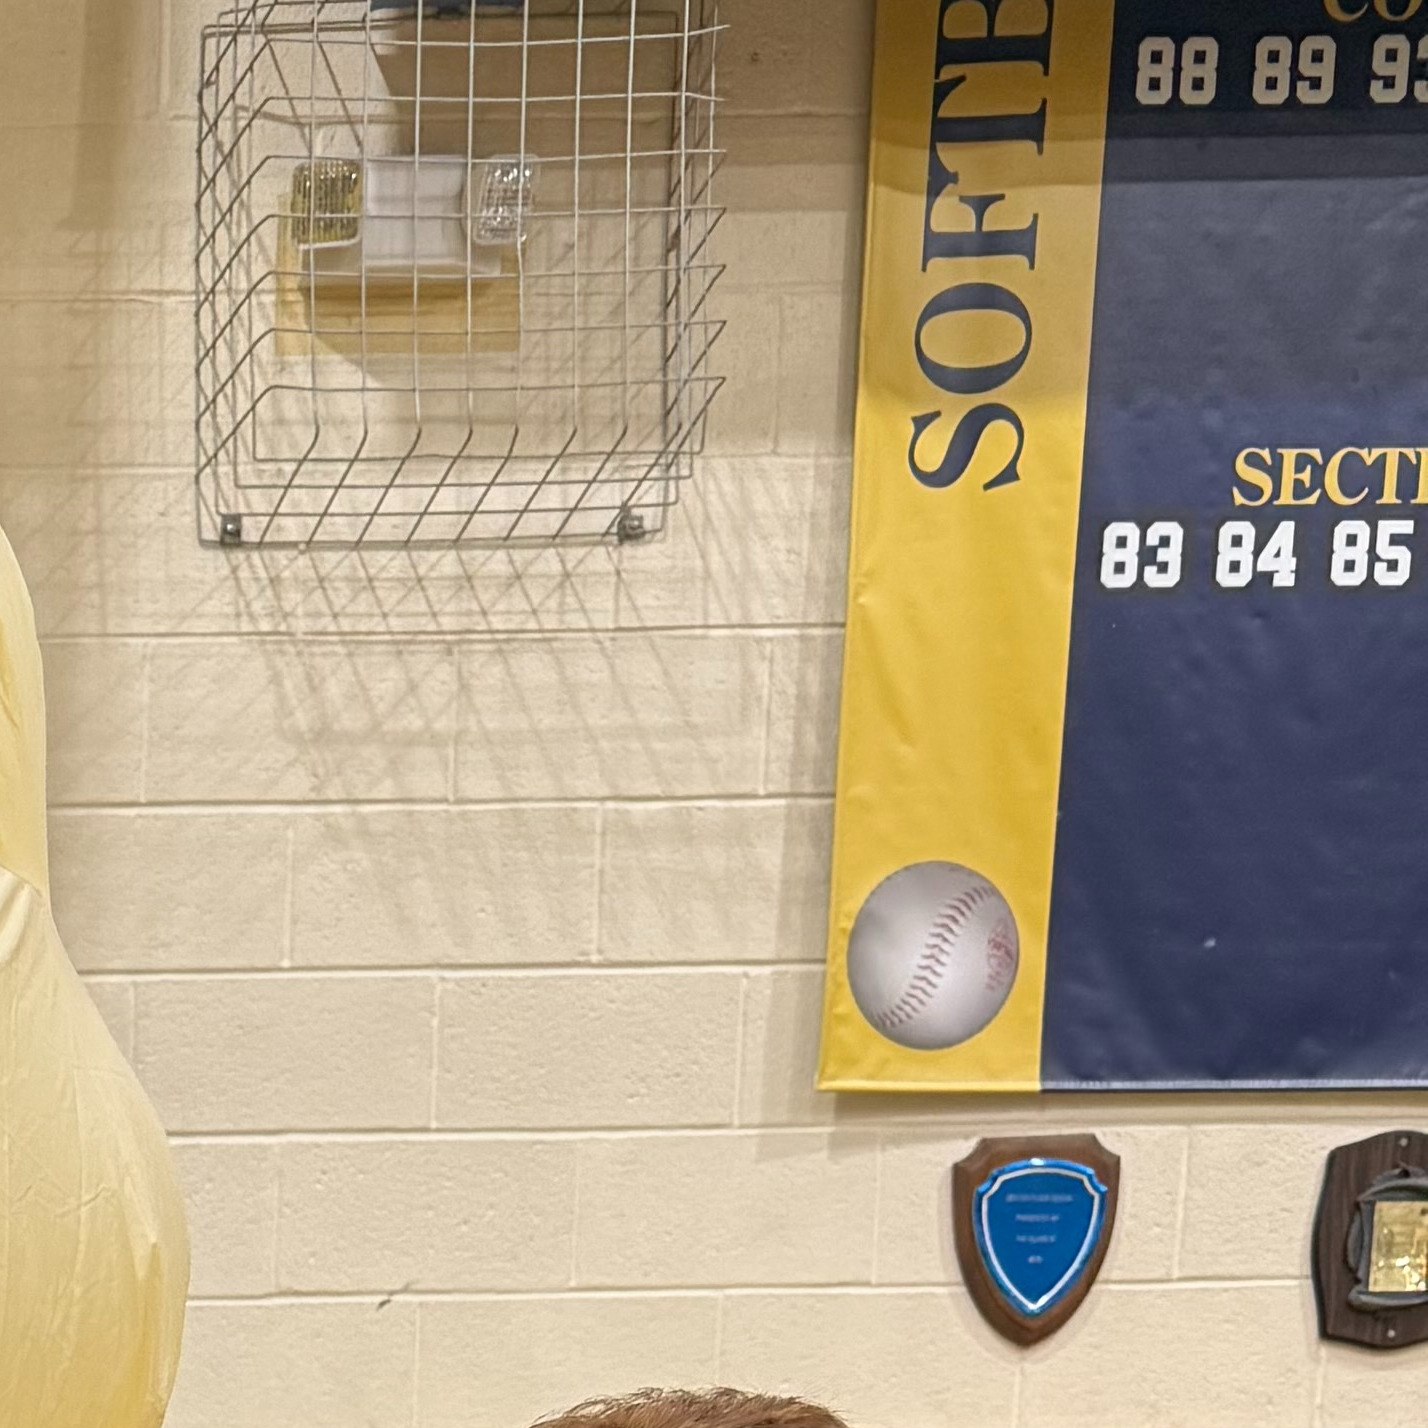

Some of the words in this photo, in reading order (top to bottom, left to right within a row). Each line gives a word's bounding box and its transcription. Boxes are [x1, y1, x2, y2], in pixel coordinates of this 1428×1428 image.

[1135, 36, 1219, 105] 88
[1252, 35, 1337, 105] 89
[908, 0, 1054, 491] SOFTB
[1100, 522, 1184, 588] 83
[1215, 521, 1297, 588] 84
[1330, 520, 1414, 586] 85
